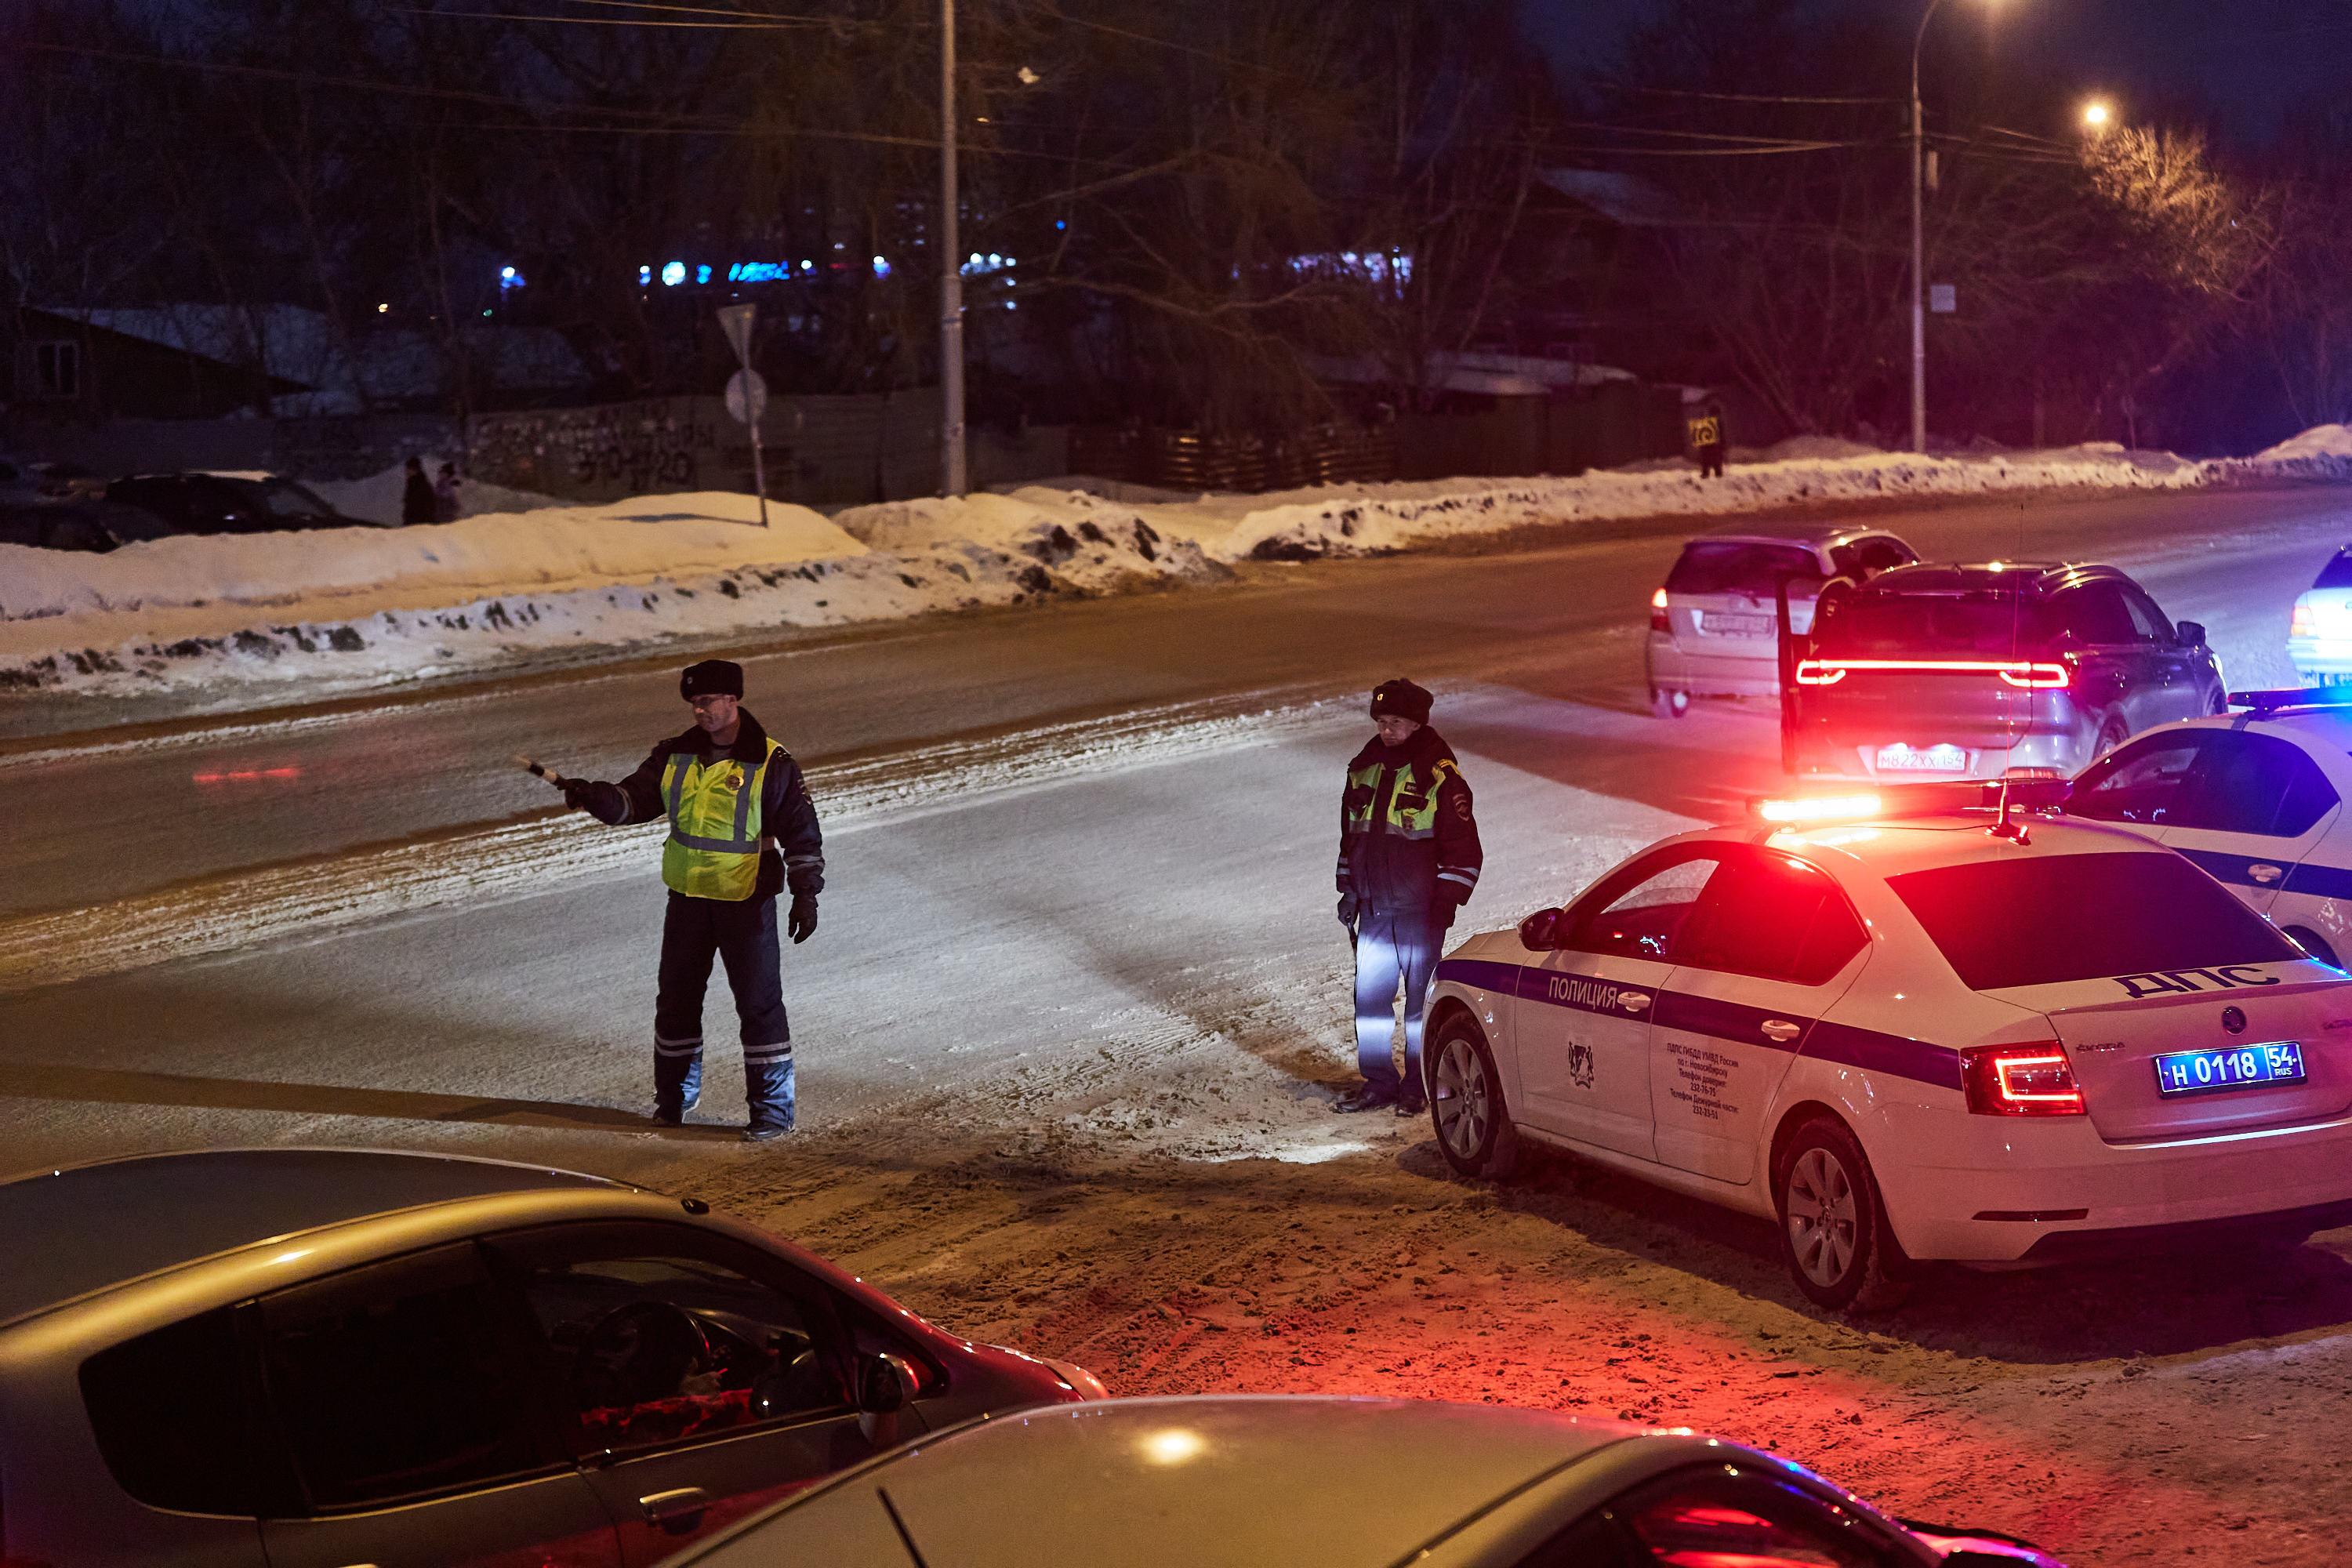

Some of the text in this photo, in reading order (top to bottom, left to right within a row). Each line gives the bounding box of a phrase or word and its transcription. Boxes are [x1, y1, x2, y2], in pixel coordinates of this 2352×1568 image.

[2112, 967, 2281, 998] ДПС
[1548, 977, 1617, 1010] ПОЛИЦИЯ
[1682, 1046, 1701, 1060] ГИБДД
[1702, 1051, 1719, 1065] УМВД
[1719, 1055, 1739, 1068] России
[2268, 1047, 2293, 1068] 54
[1679, 1068, 1701, 1081] Телефон
[1690, 1061, 1728, 1079] Новосибирску
[2274, 1067, 2293, 1076] RUS
[1670, 1087, 1693, 1102] Телефон
[1690, 1083, 1716, 1097] 232-76-75
[1693, 1105, 1718, 1120] 232-23-51
